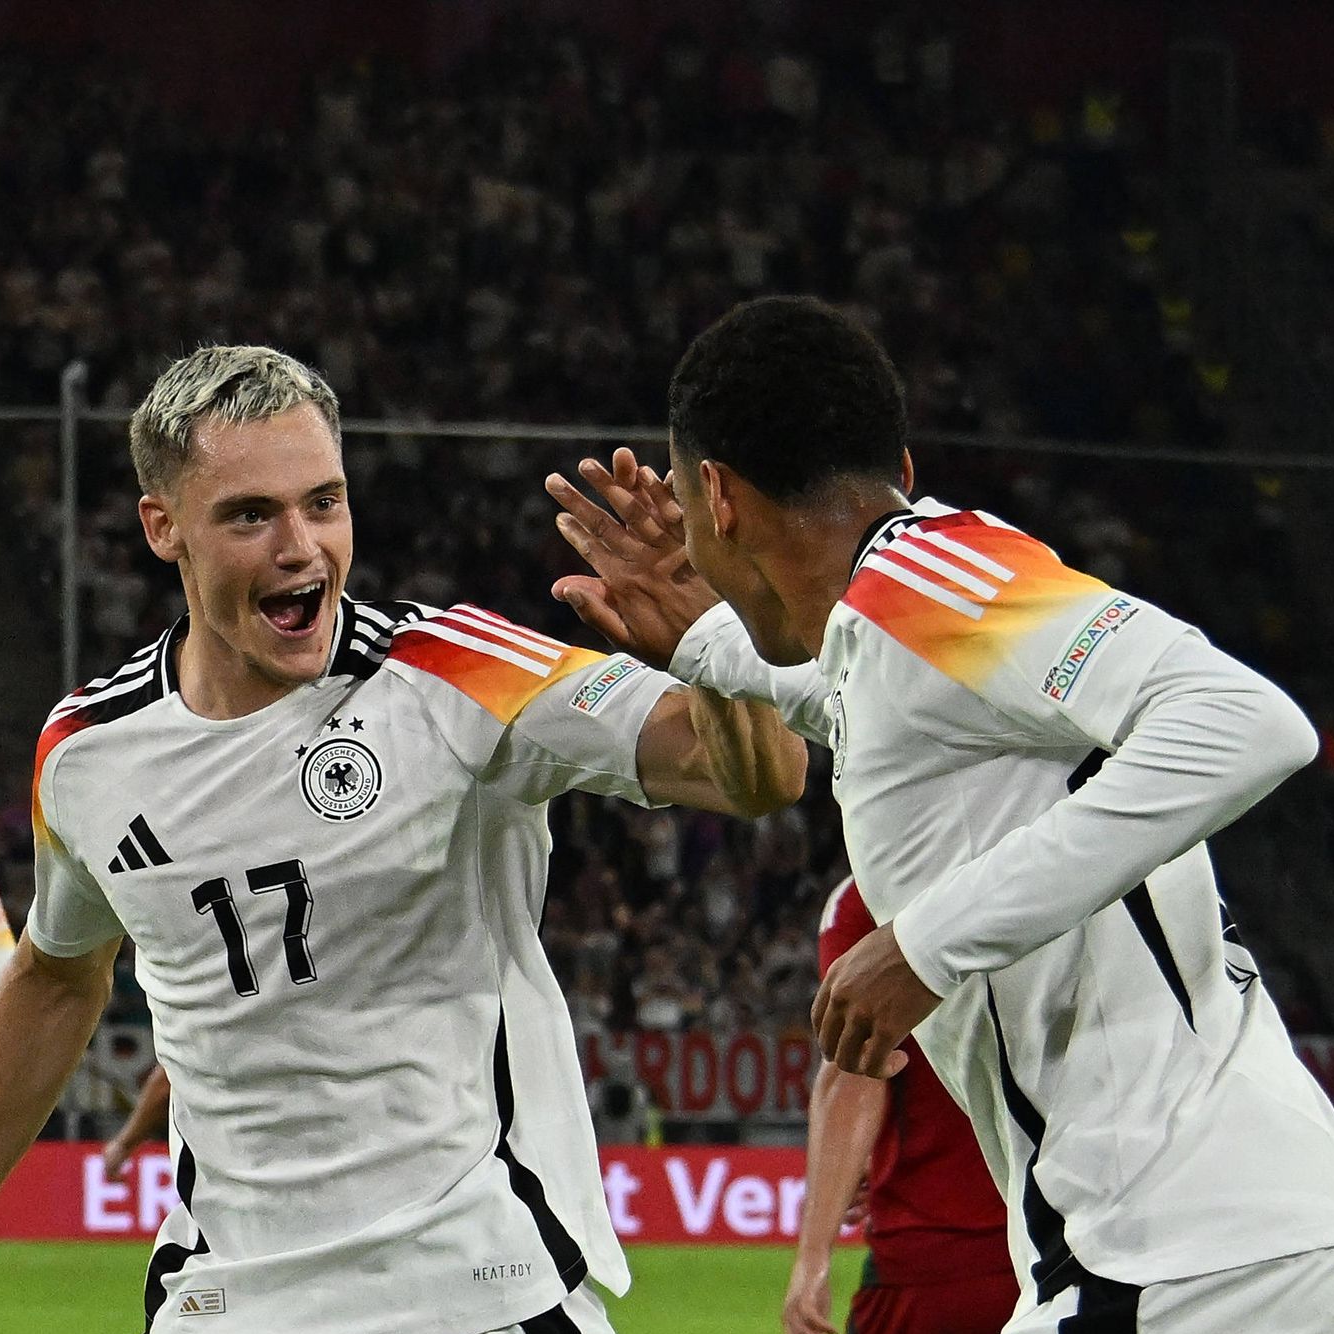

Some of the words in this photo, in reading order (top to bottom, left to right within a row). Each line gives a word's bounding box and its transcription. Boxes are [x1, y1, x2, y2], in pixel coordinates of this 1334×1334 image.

[578, 660, 638, 710] FOUNDAT
[314, 749, 357, 772] DEUTSCHER
[191, 859, 317, 997] 17
[83, 1154, 179, 1233] ER
[667, 1157, 807, 1237] Ver
